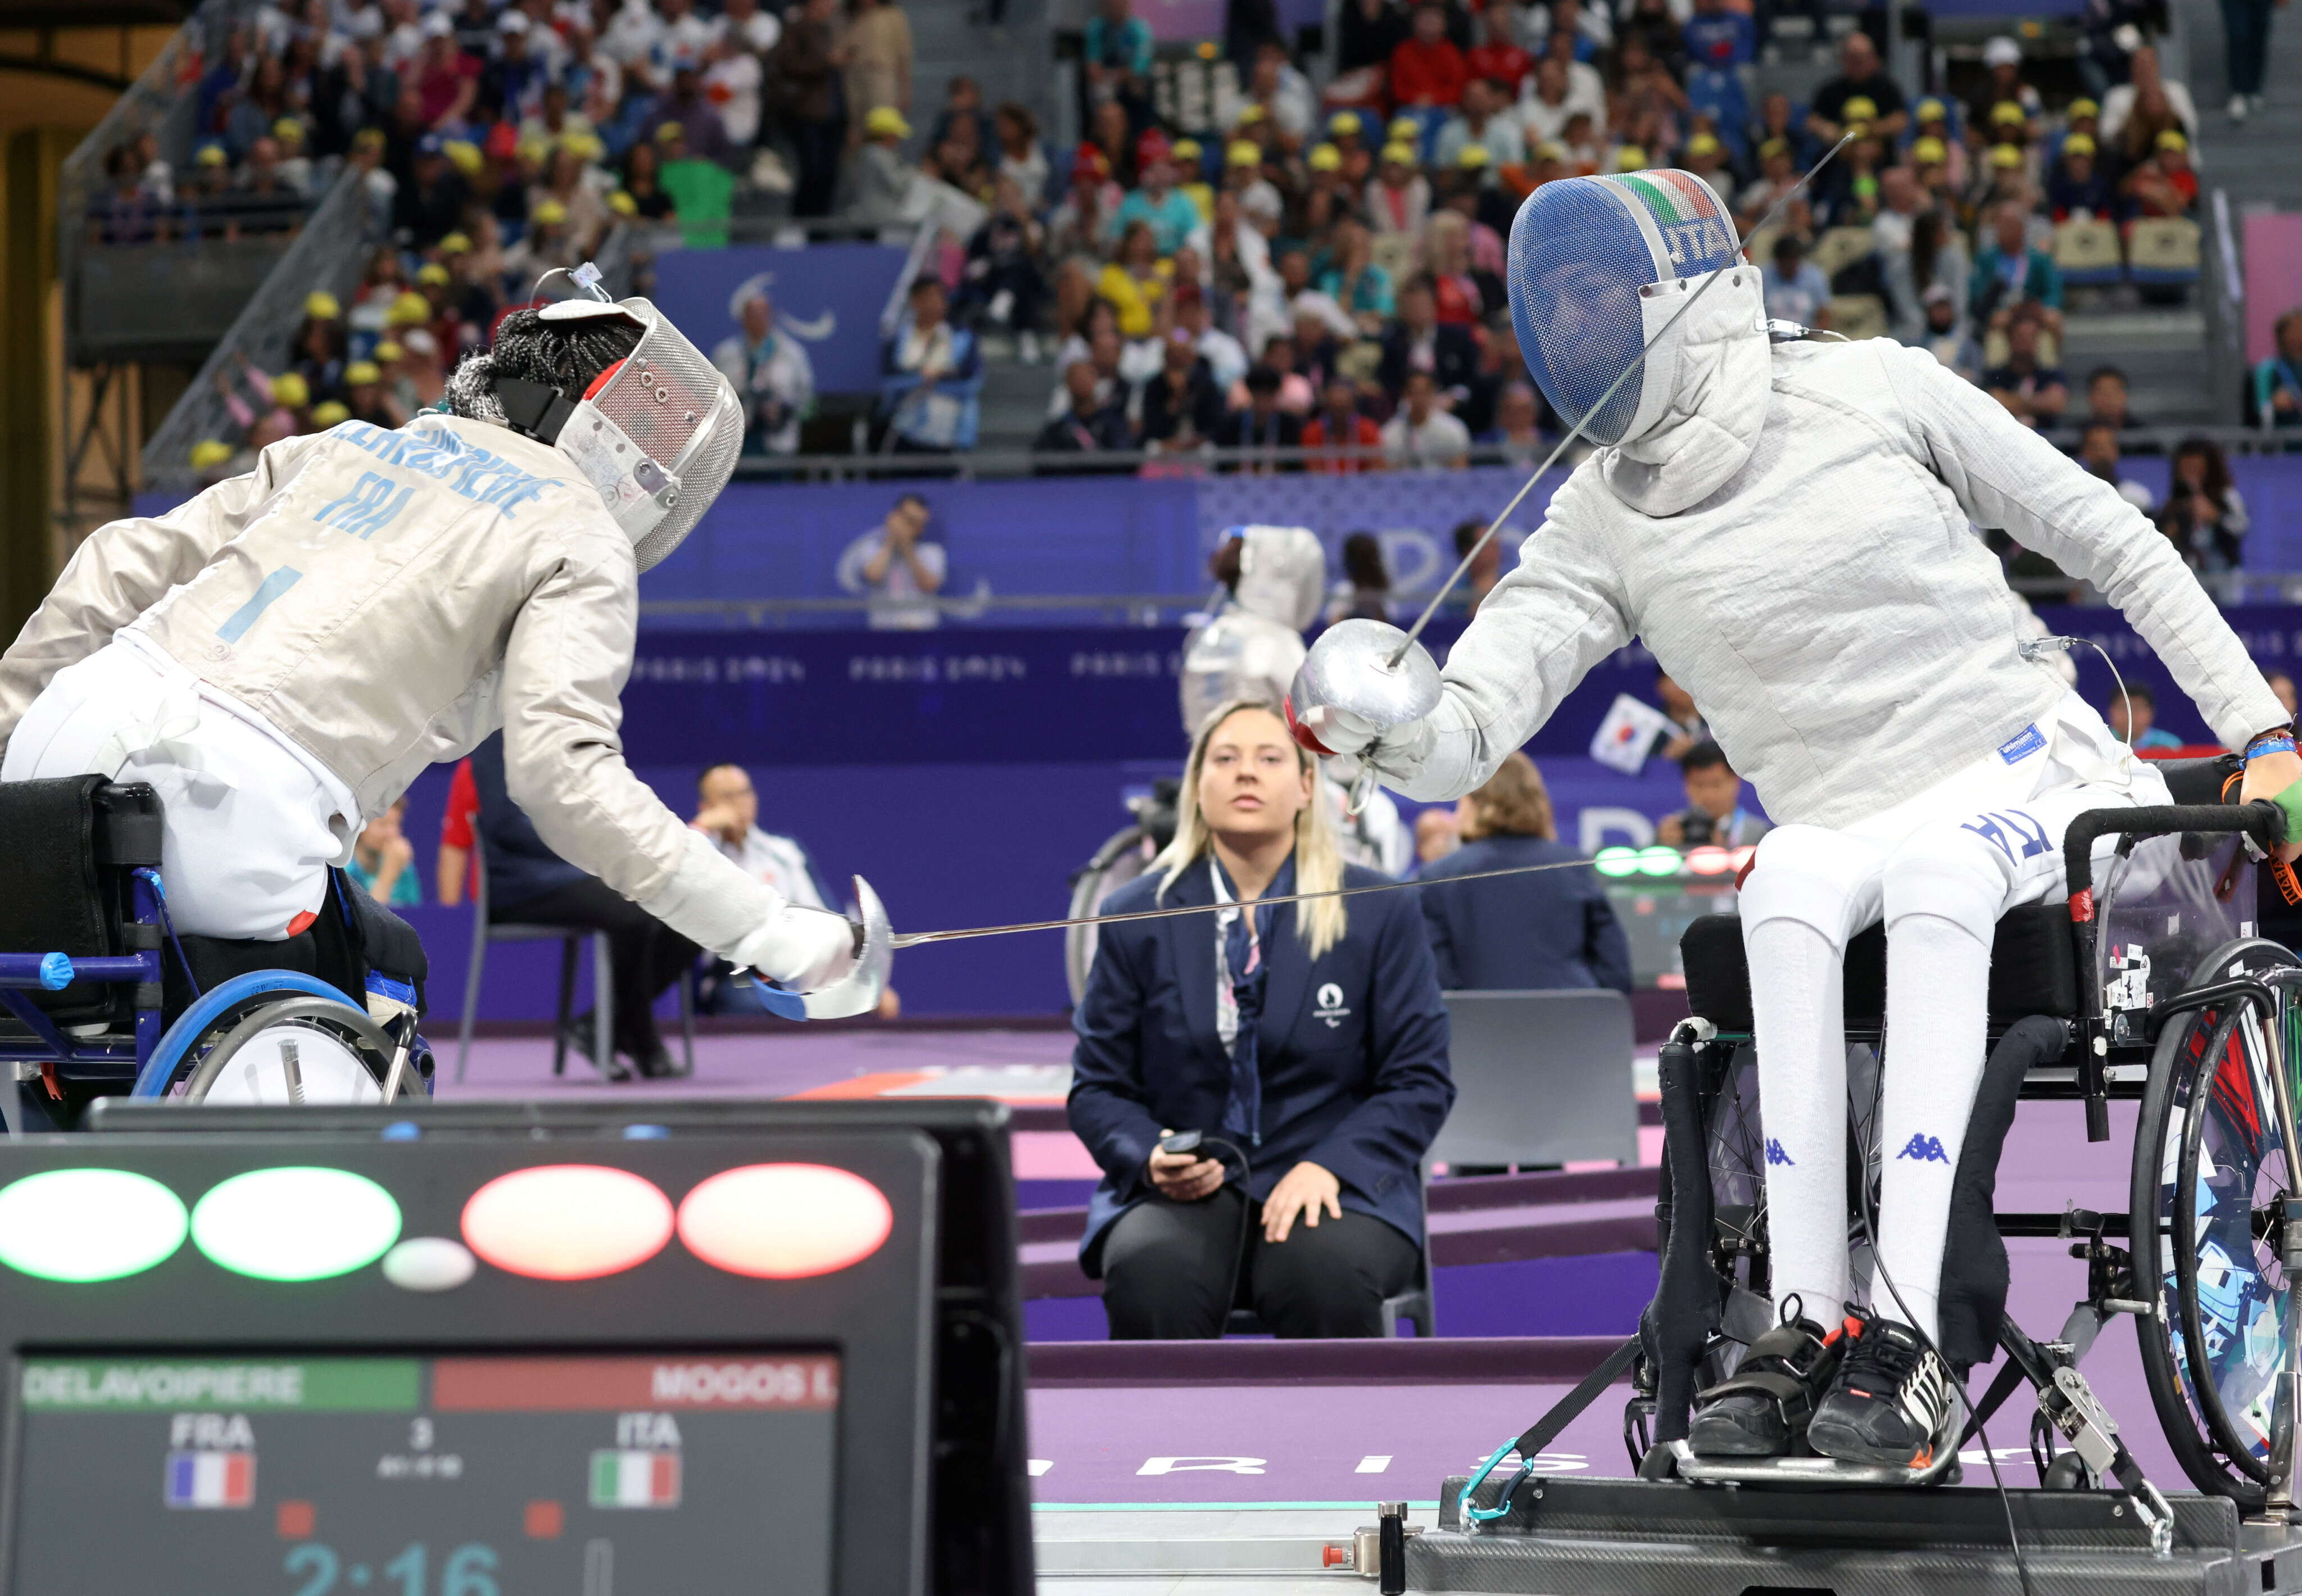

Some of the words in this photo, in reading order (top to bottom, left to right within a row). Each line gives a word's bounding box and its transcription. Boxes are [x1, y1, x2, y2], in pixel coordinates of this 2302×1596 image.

[1665, 223, 1733, 262] ITA
[313, 471, 416, 540] FRA
[1960, 809, 2054, 868] ITA
[21, 1364, 305, 1405] DELAVOIPIERE
[651, 1363, 807, 1402] MOGOS
[170, 1413, 255, 1450] FRA
[410, 1416, 435, 1451] 3
[615, 1412, 682, 1448] ITA
